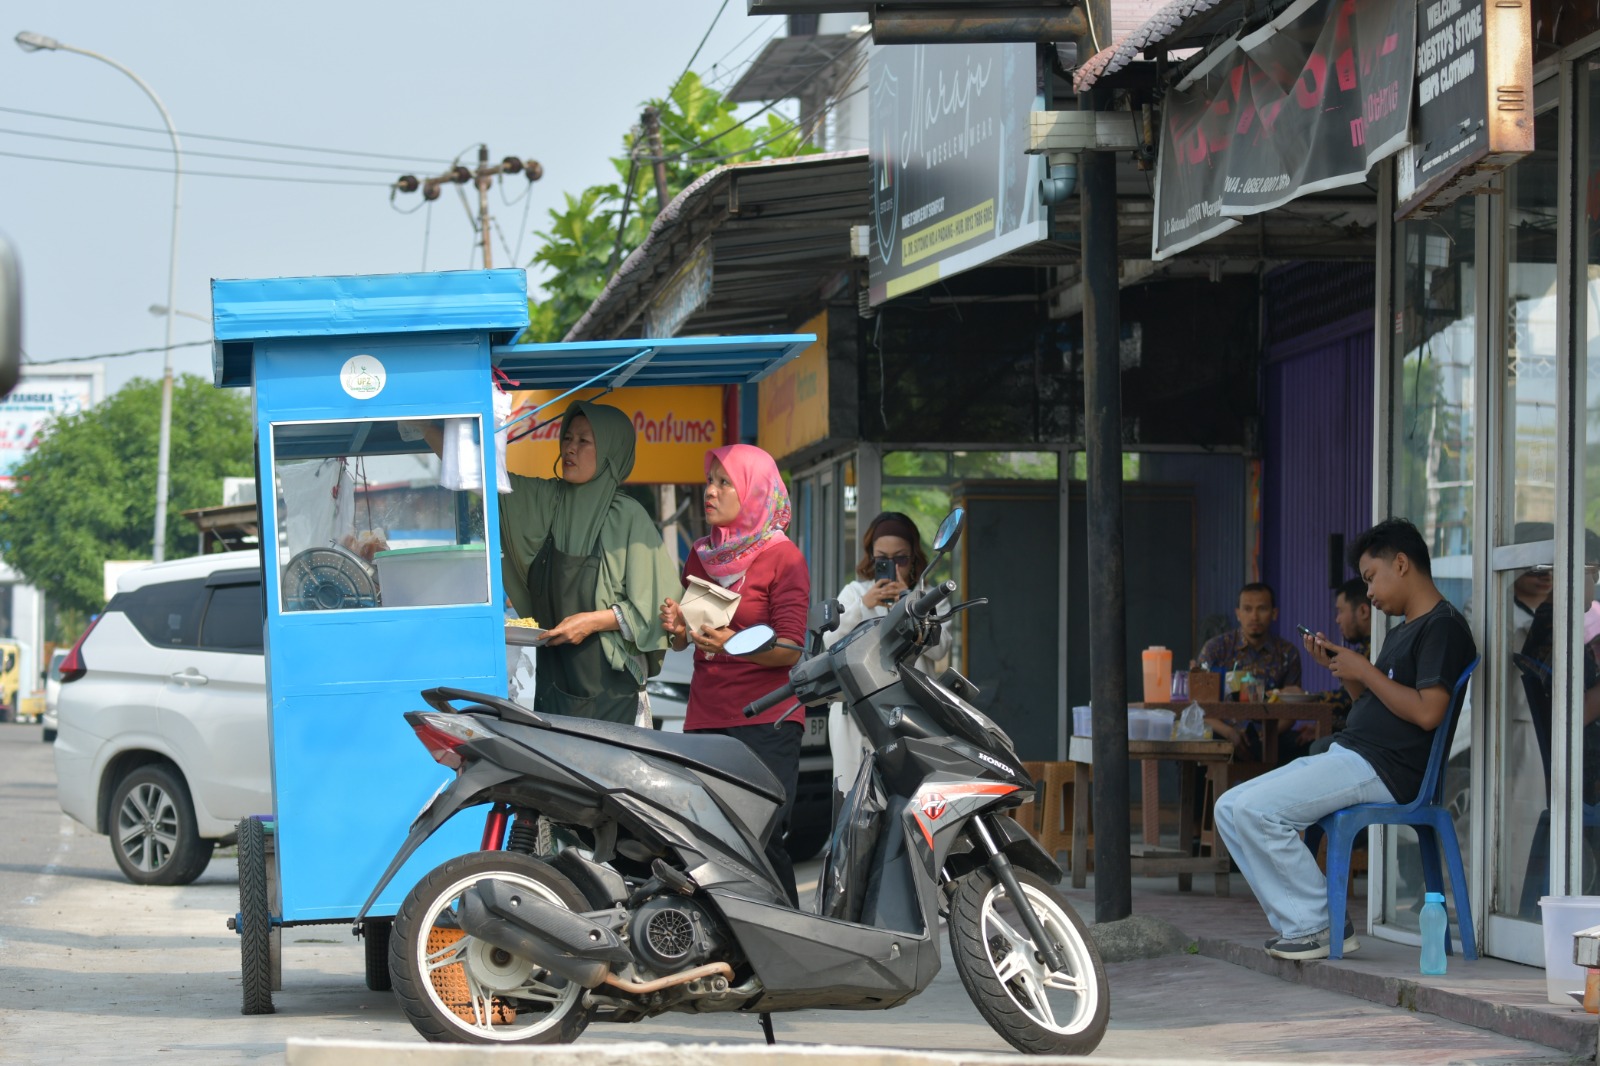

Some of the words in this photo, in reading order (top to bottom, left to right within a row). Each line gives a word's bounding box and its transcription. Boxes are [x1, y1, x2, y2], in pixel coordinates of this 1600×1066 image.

[1427, 0, 1462, 31] WELCOME
[1455, 3, 1483, 51] STORE
[1419, 72, 1440, 108] MEN'S
[1440, 48, 1475, 93] CLOTHING
[926, 132, 964, 170] MOESLEM
[969, 116, 993, 148] WEAR
[632, 410, 716, 443] Parfume
[978, 752, 1016, 777] HONDA
